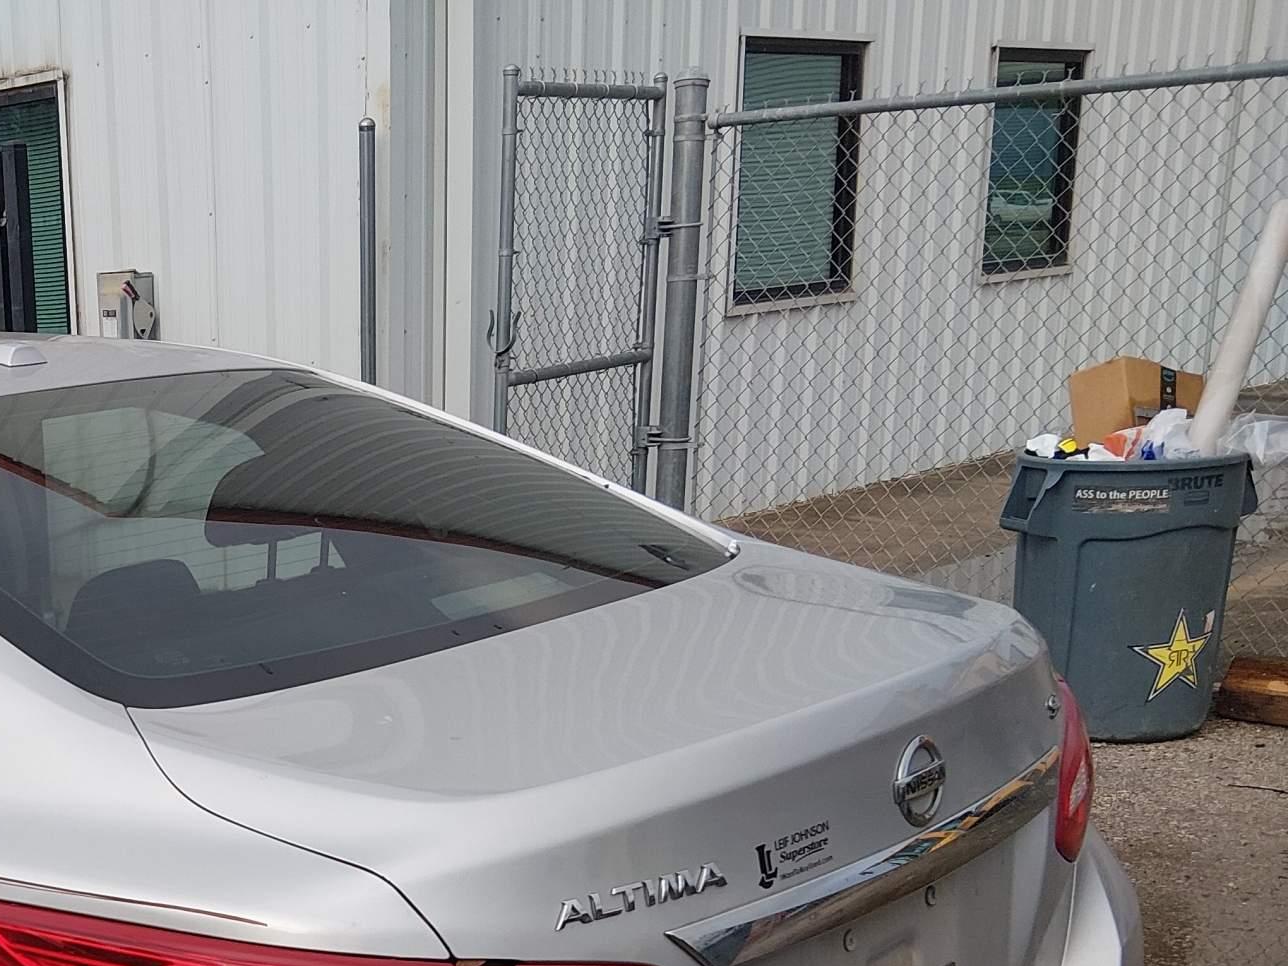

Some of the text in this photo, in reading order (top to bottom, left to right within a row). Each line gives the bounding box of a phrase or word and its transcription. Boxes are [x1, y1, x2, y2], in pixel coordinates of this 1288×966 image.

[1075, 489, 1169, 499] ASS to the PEOPLE
[790, 820, 830, 846] JOHNSON
[554, 861, 728, 932] ALTIMA
